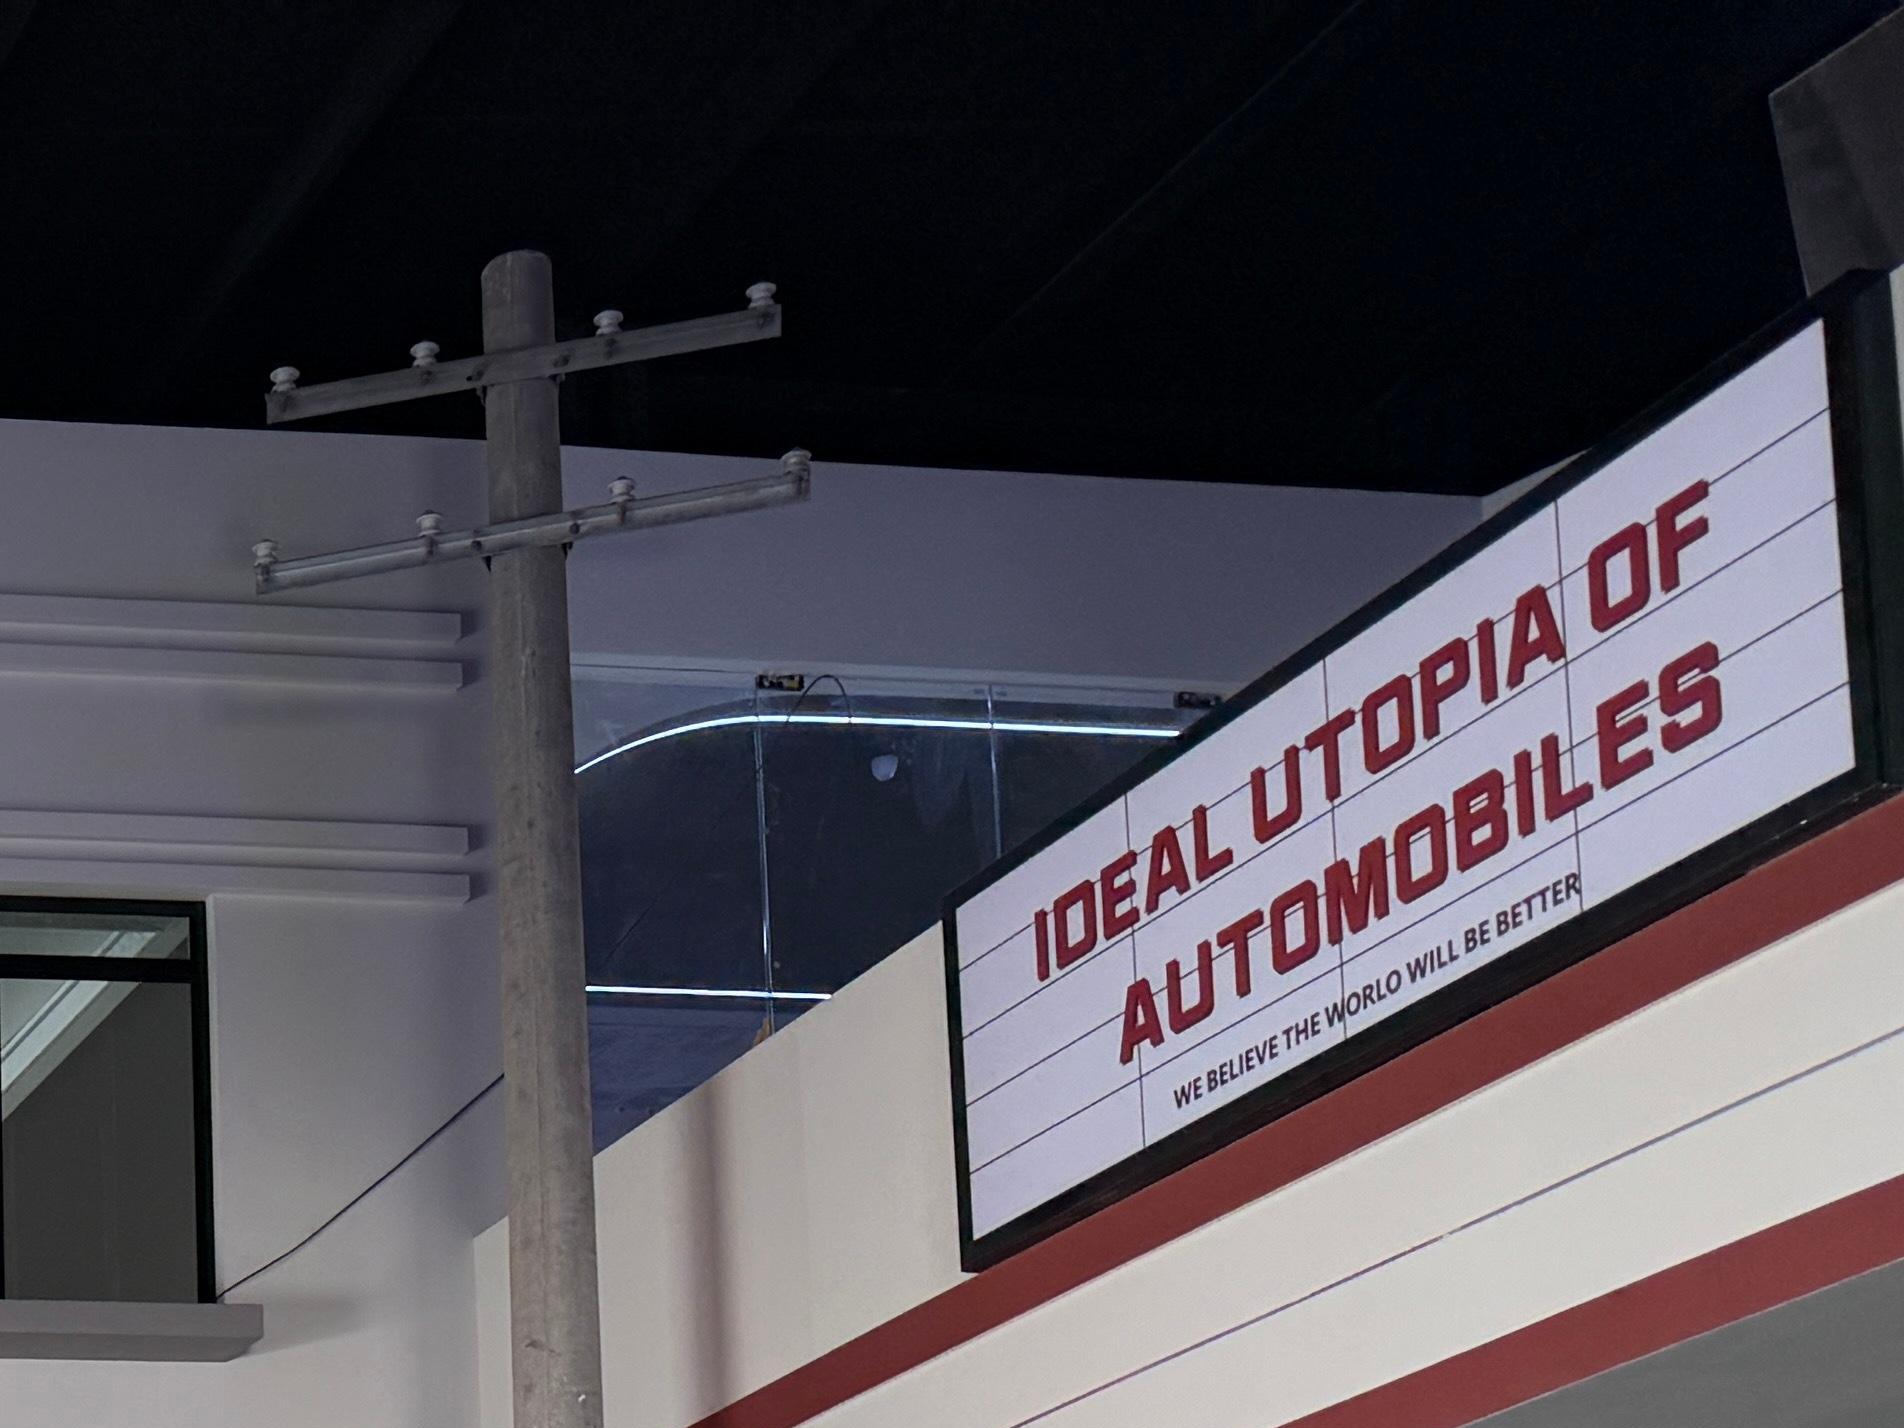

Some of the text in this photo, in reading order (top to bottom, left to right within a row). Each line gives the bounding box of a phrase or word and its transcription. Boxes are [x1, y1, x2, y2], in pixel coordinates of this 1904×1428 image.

[1033, 479, 1710, 982] IDEAL UTOPIA OF
[1118, 640, 1724, 1066] AUTOMOBILES
[1173, 1076, 1204, 1109] WE
[1206, 1034, 1280, 1093] BELIEVE
[1282, 1011, 1322, 1051] THE
[1406, 938, 1460, 984] WILL
[1464, 918, 1492, 956] BE
[1495, 871, 1581, 938] BETTER
